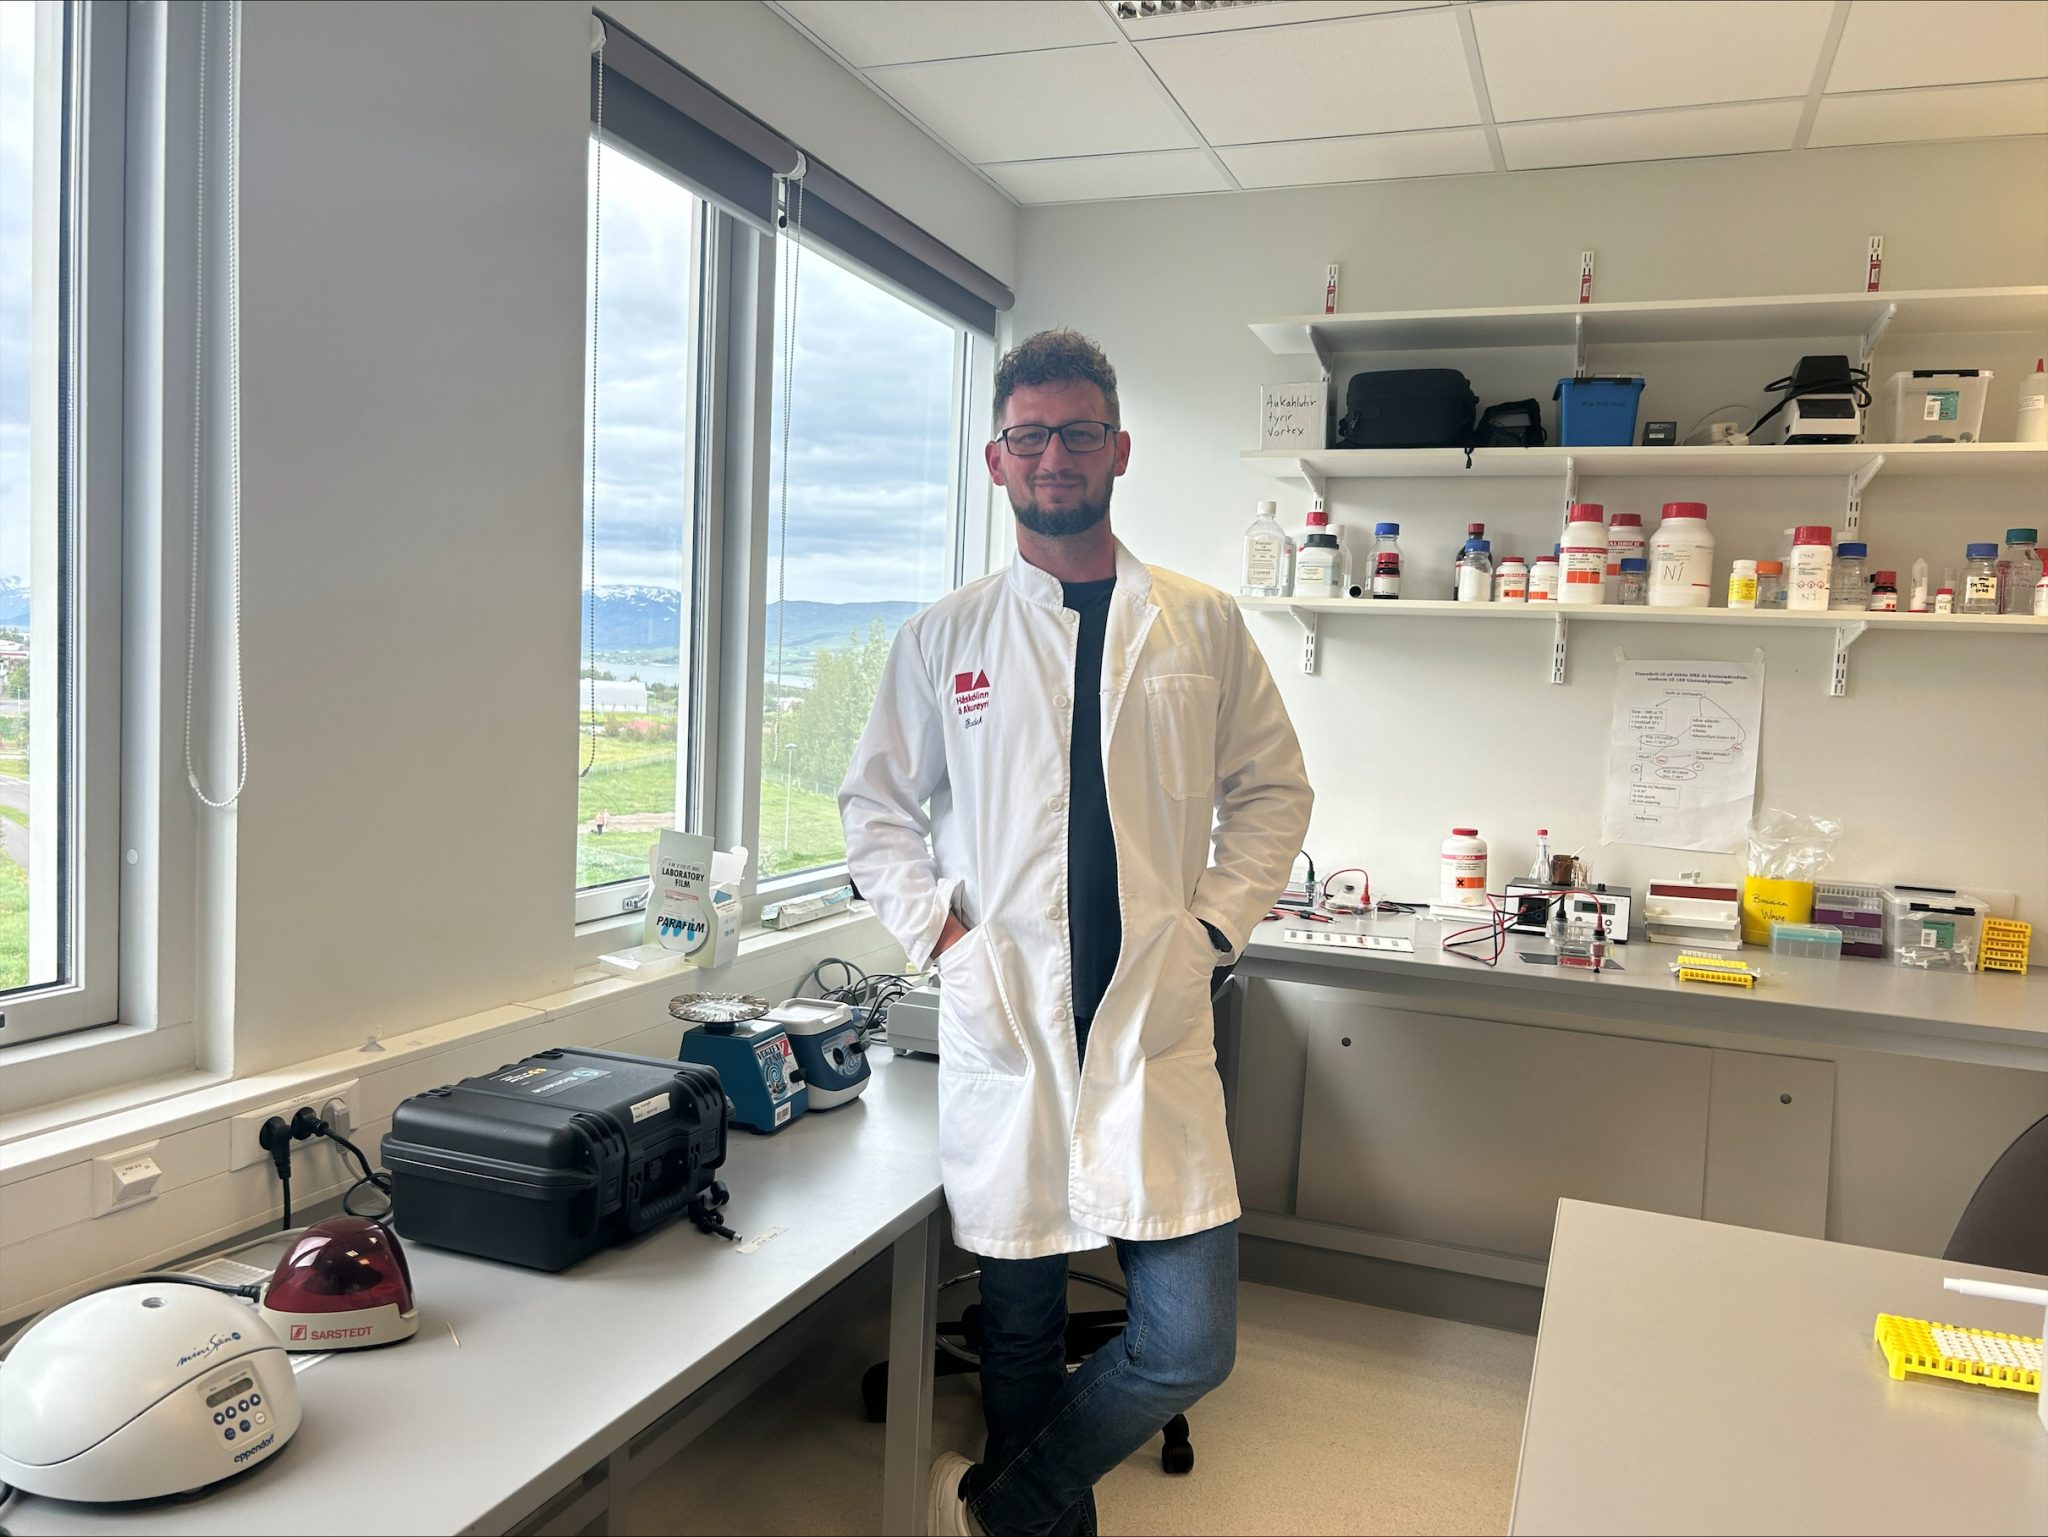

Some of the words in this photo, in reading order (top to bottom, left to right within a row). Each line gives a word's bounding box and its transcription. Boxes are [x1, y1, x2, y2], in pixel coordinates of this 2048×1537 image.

[662, 867, 705, 882] LABORATORY
[675, 879, 691, 888] FILM
[656, 916, 705, 933] PARAFILM
[311, 1326, 374, 1341] SARSTEDT
[234, 1434, 276, 1463] eppendorf
